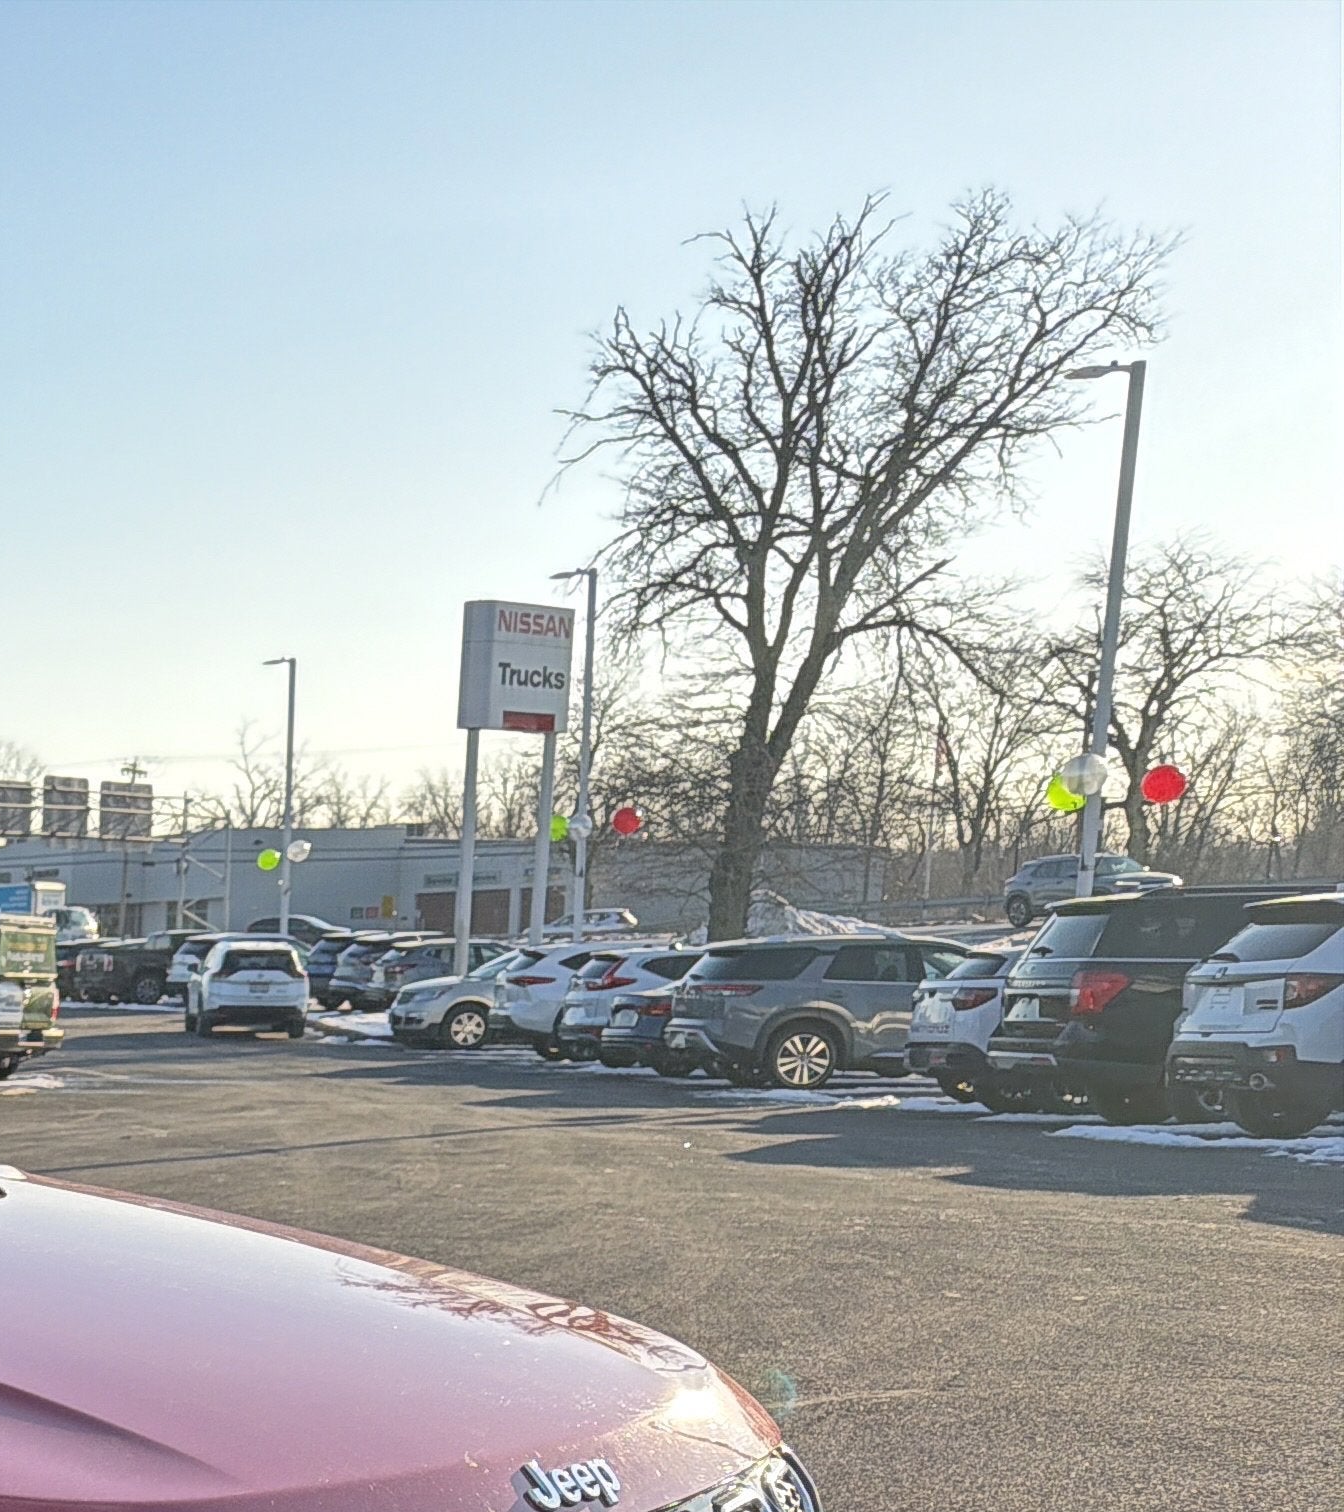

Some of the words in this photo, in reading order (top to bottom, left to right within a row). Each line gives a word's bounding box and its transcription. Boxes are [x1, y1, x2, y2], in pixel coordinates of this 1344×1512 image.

[499, 609, 571, 638] NISSAN
[499, 663, 565, 689] Trucks
[520, 1459, 621, 1512] Jeep
